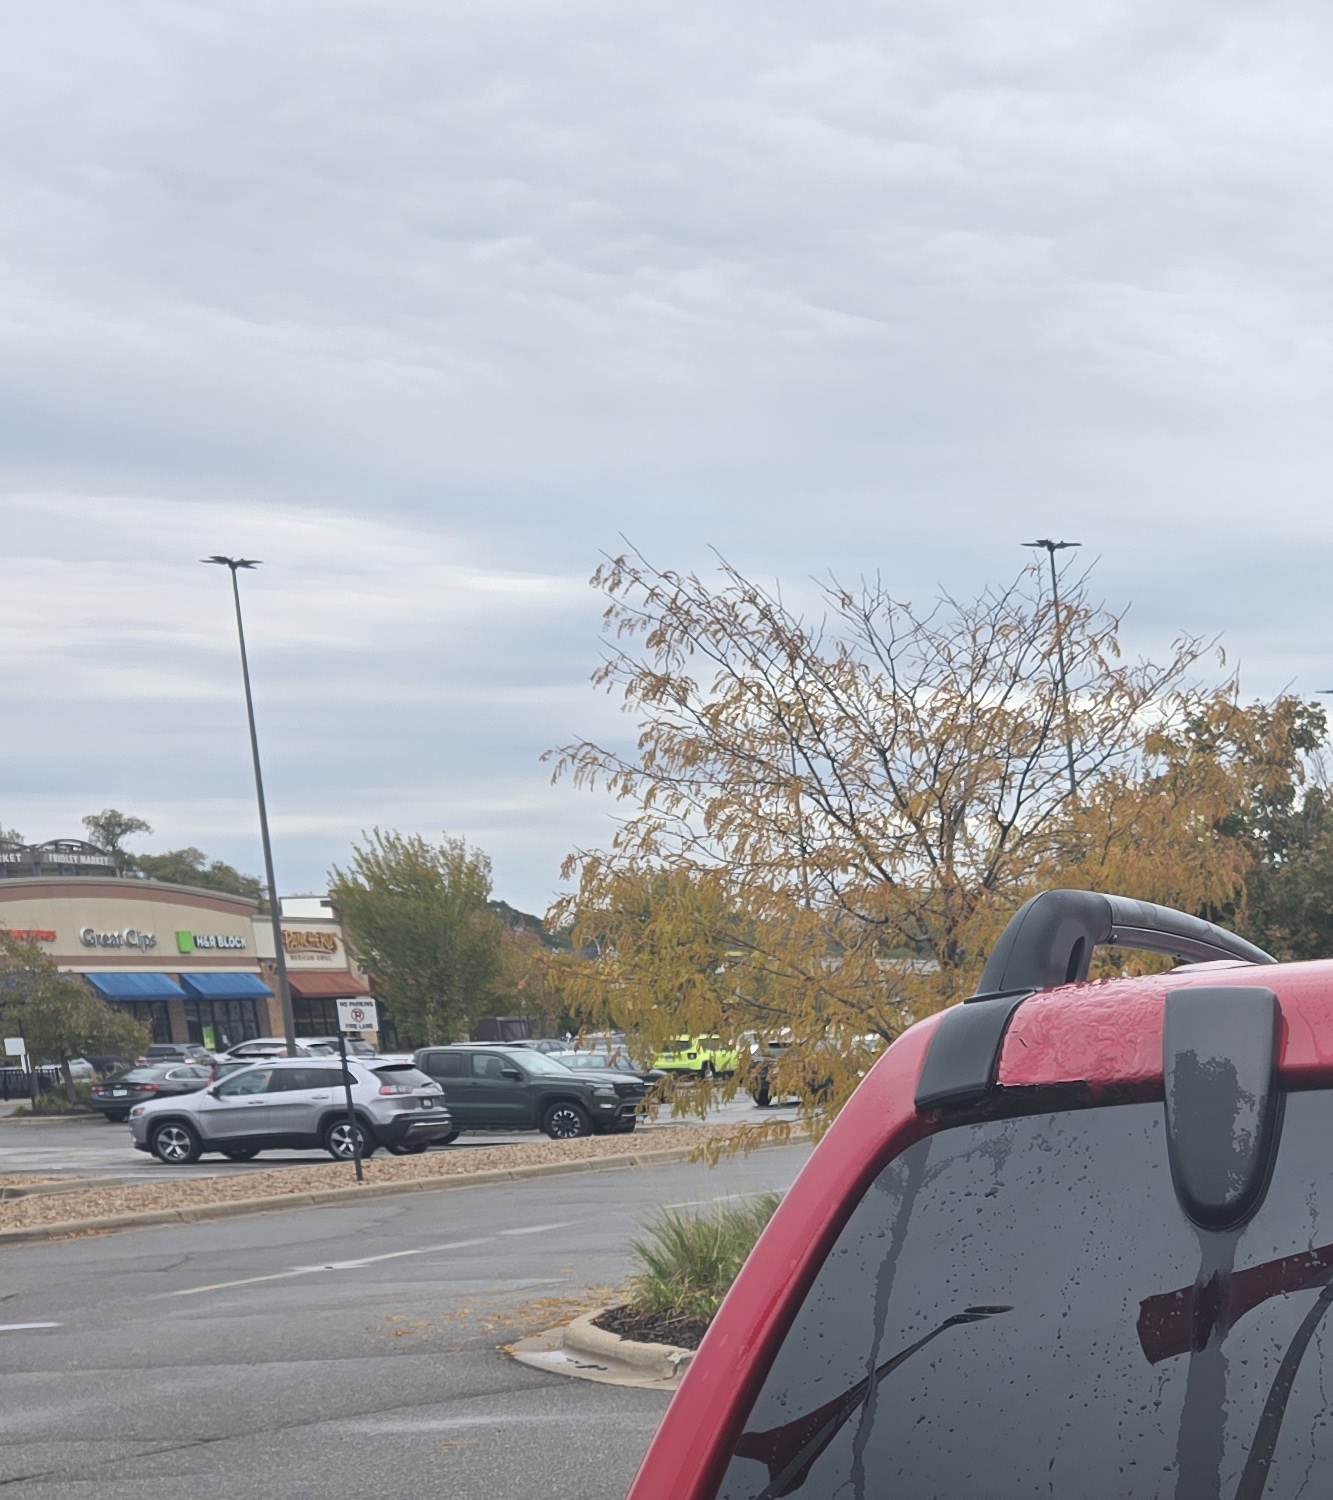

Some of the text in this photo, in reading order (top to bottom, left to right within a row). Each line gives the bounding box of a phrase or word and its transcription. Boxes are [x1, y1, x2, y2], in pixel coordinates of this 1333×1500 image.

[79, 927, 122, 947] Great
[123, 928, 157, 953] Clips
[194, 935, 247, 949] H&R BLOCK
